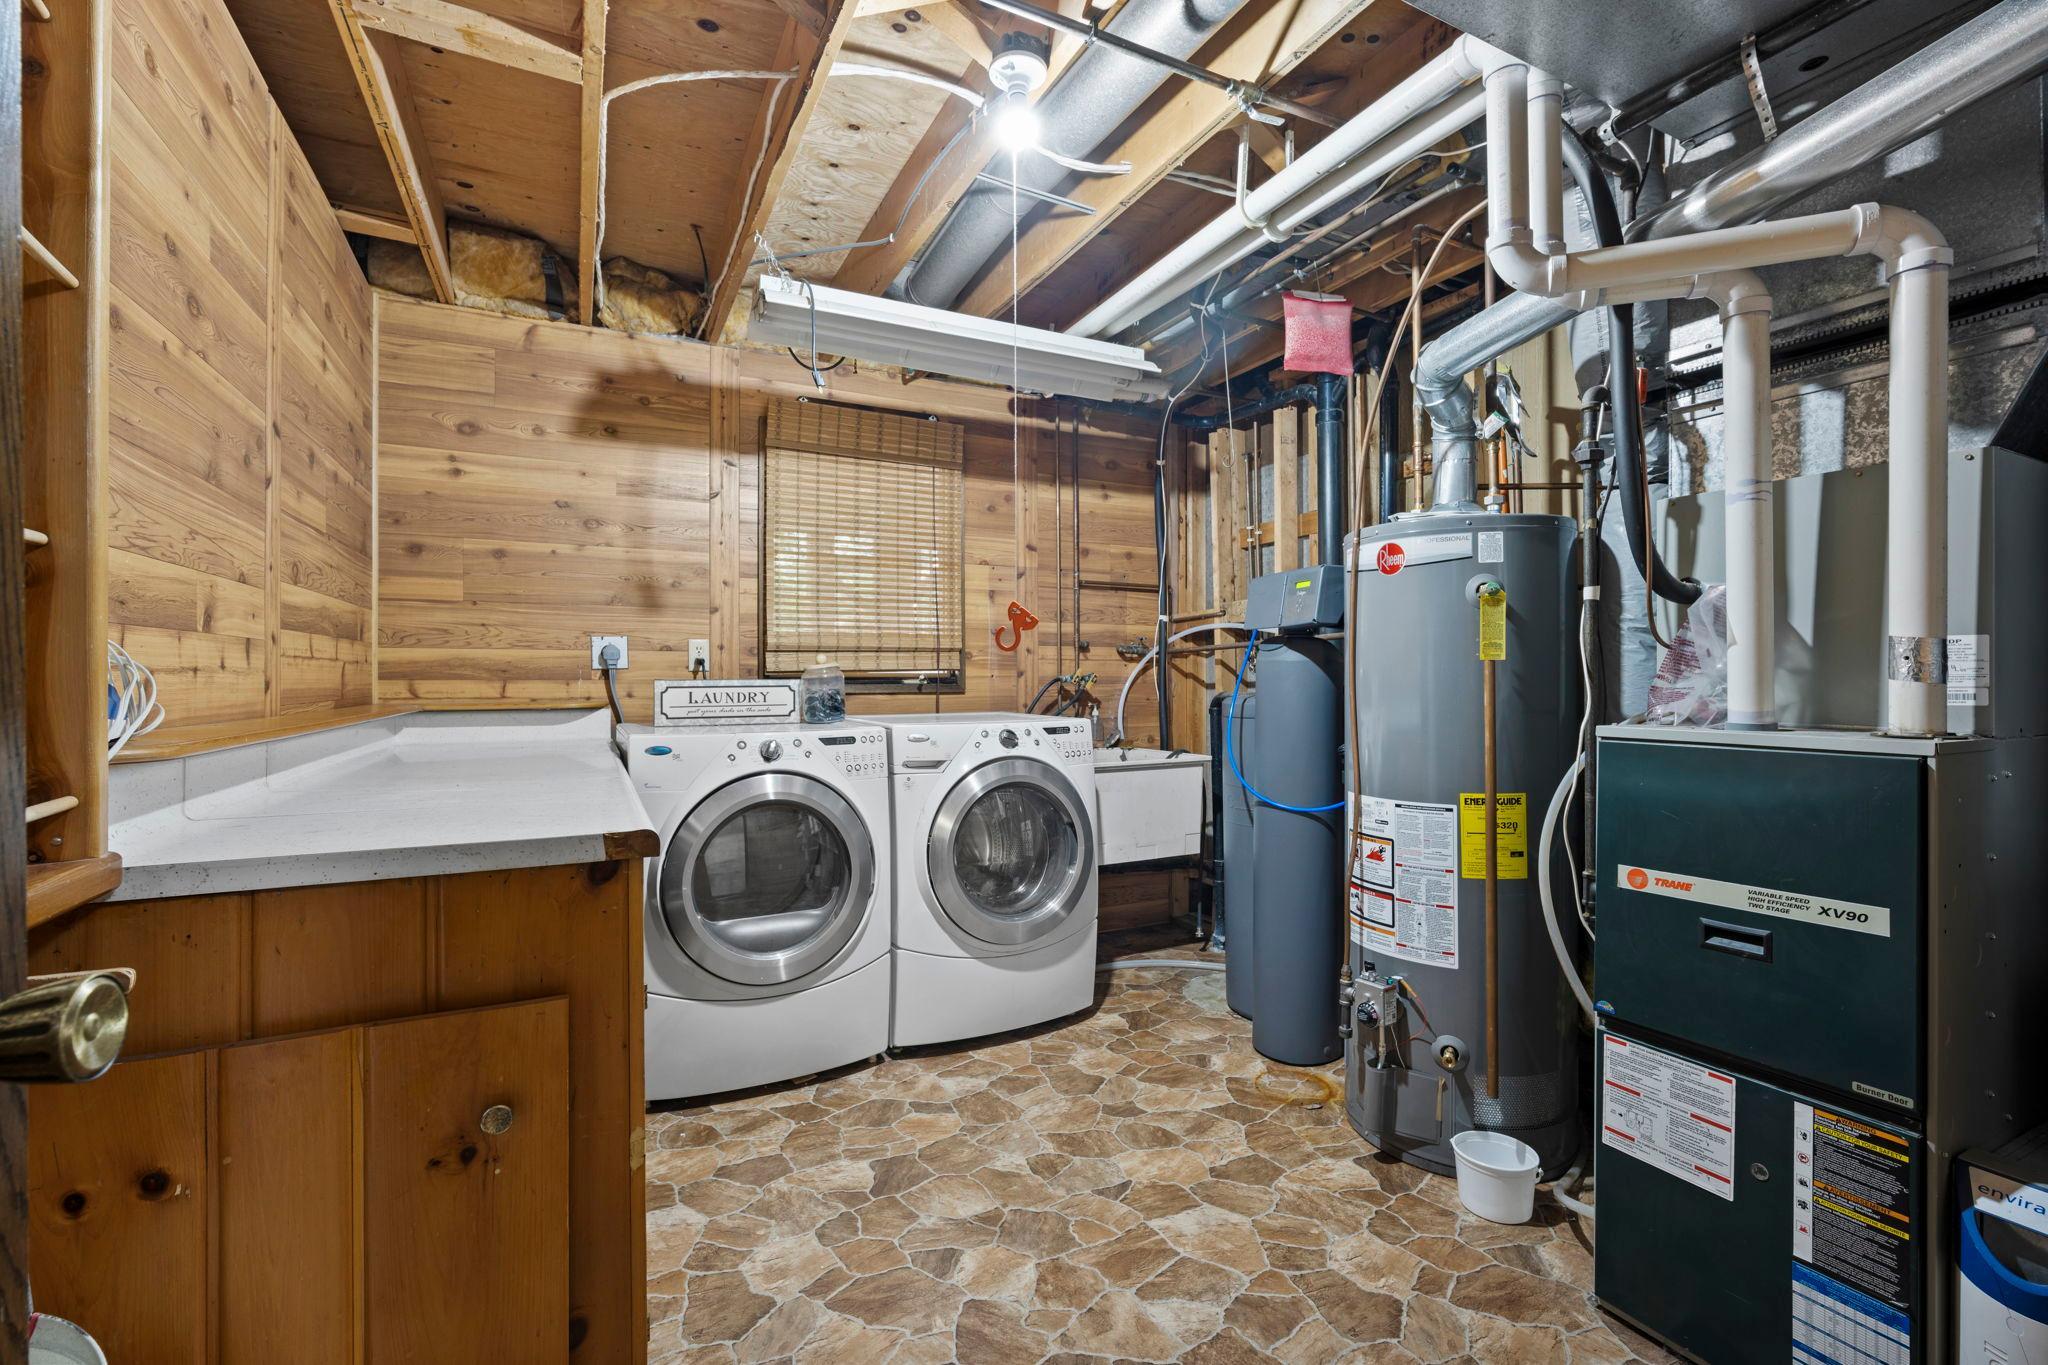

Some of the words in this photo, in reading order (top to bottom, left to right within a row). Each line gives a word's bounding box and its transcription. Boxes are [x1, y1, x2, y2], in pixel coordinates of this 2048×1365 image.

[1378, 544, 1404, 565] Rheem
[688, 691, 770, 704] LAUNDRY
[1464, 798, 1522, 806] ENERGUIDE
[1654, 877, 1693, 892] TRANE
[1748, 889, 1784, 900] VARIABLE
[1785, 896, 1810, 905] SPEED
[1748, 902, 1764, 910] TWO
[1765, 905, 1791, 914] STAGE
[1748, 896, 1766, 904] HIGH
[1767, 899, 1811, 911] EFFICIENCY
[1818, 906, 1869, 923] XV90
[1856, 1084, 1885, 1099] Burner
[1888, 1092, 1909, 1106] Door
[1978, 1184, 2046, 1215] envira
